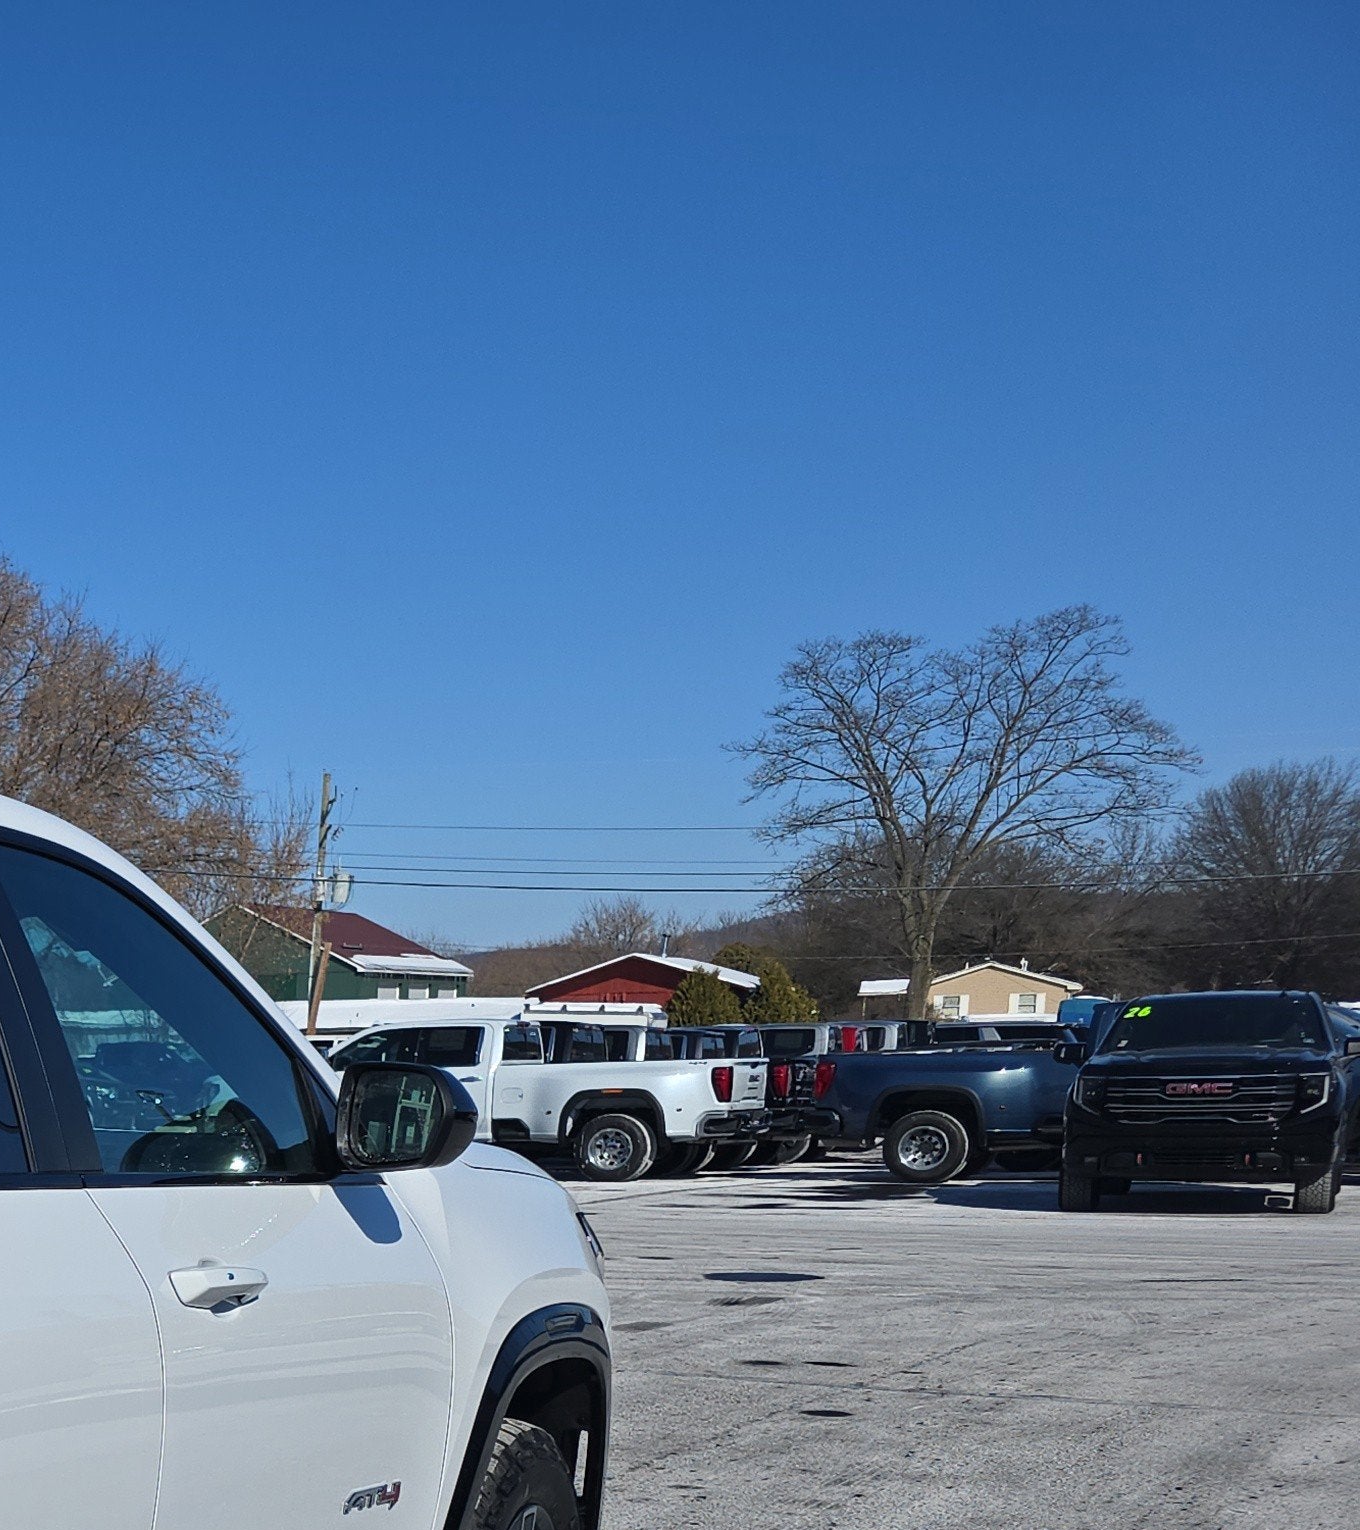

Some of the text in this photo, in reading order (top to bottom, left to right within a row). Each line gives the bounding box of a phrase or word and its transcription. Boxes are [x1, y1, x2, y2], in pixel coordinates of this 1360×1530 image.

[1123, 1006, 1152, 1019] 26
[1166, 1082, 1233, 1095] GMC
[342, 1479, 402, 1515] AT4
